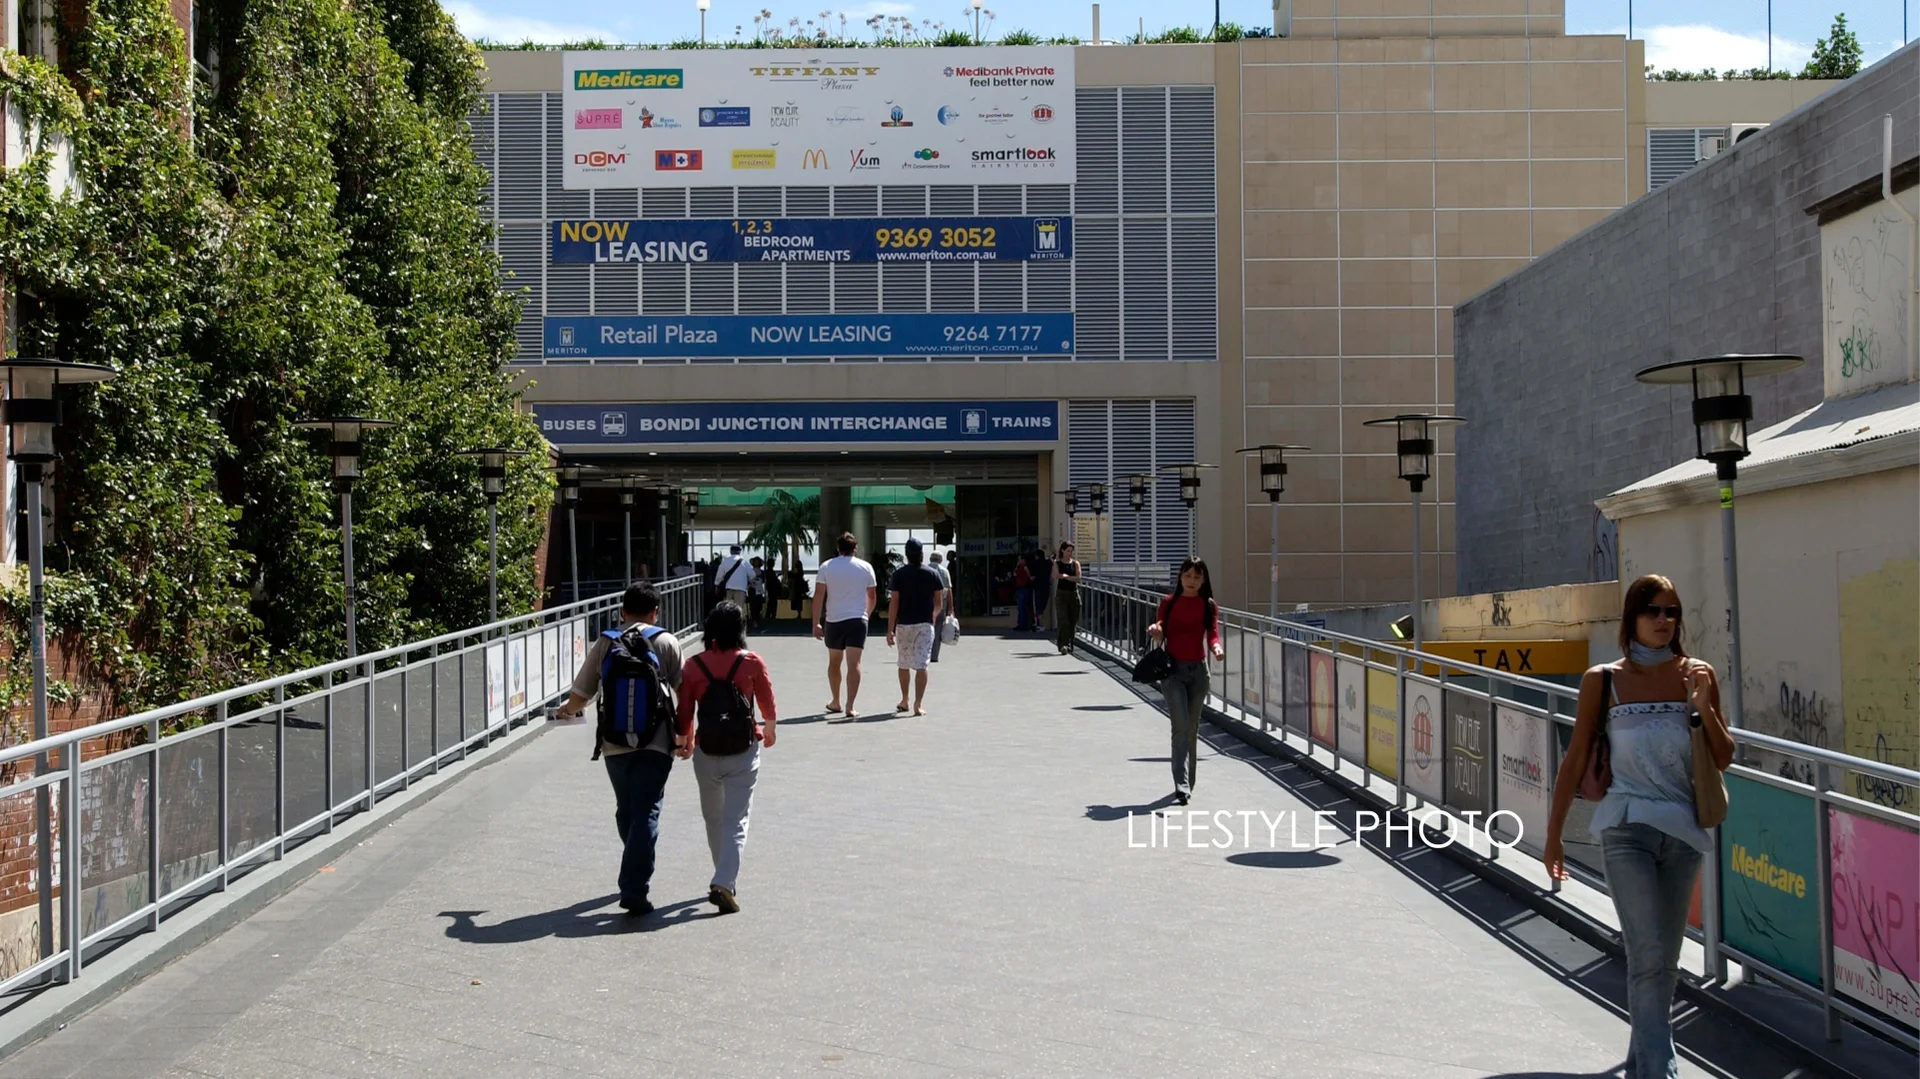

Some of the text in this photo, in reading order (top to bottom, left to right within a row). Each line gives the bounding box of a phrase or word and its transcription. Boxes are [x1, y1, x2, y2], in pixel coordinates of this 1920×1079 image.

[578, 71, 680, 88] Medicare
[749, 67, 880, 76] TIFFANY
[956, 66, 1055, 77] Medibank Private
[820, 78, 852, 90] Plaza
[970, 78, 1055, 87] feel better now
[577, 113, 620, 124] SUPRÉ
[771, 118, 799, 127] BEAUTY
[575, 151, 625, 167] DCM
[658, 152, 698, 168] MBF
[849, 149, 880, 173] Yum
[972, 147, 1056, 160] smartlook
[560, 221, 629, 242] NOW
[876, 227, 995, 248] 9369 3052
[744, 236, 814, 247] BEDROOM
[595, 241, 708, 263] LEASING
[761, 250, 851, 261] APARTMENTS
[876, 249, 996, 261] www.meriton.com.au
[600, 324, 717, 344] Retail Plaza
[751, 325, 892, 343] NOW LEASING
[943, 325, 1042, 342] 9264 7177
[905, 343, 1038, 352] www.meriton.com.au
[543, 419, 597, 431] BUSES
[640, 416, 947, 431] BONDI JUNCTION INTERCHANGE
[992, 416, 1052, 427] TRAINS
[1474, 648, 1532, 672] TAX
[1455, 713, 1467, 746] NEW
[1503, 752, 1542, 784] smartlook
[1455, 755, 1482, 798] BEAUTY
[1731, 843, 1806, 899] Medicare
